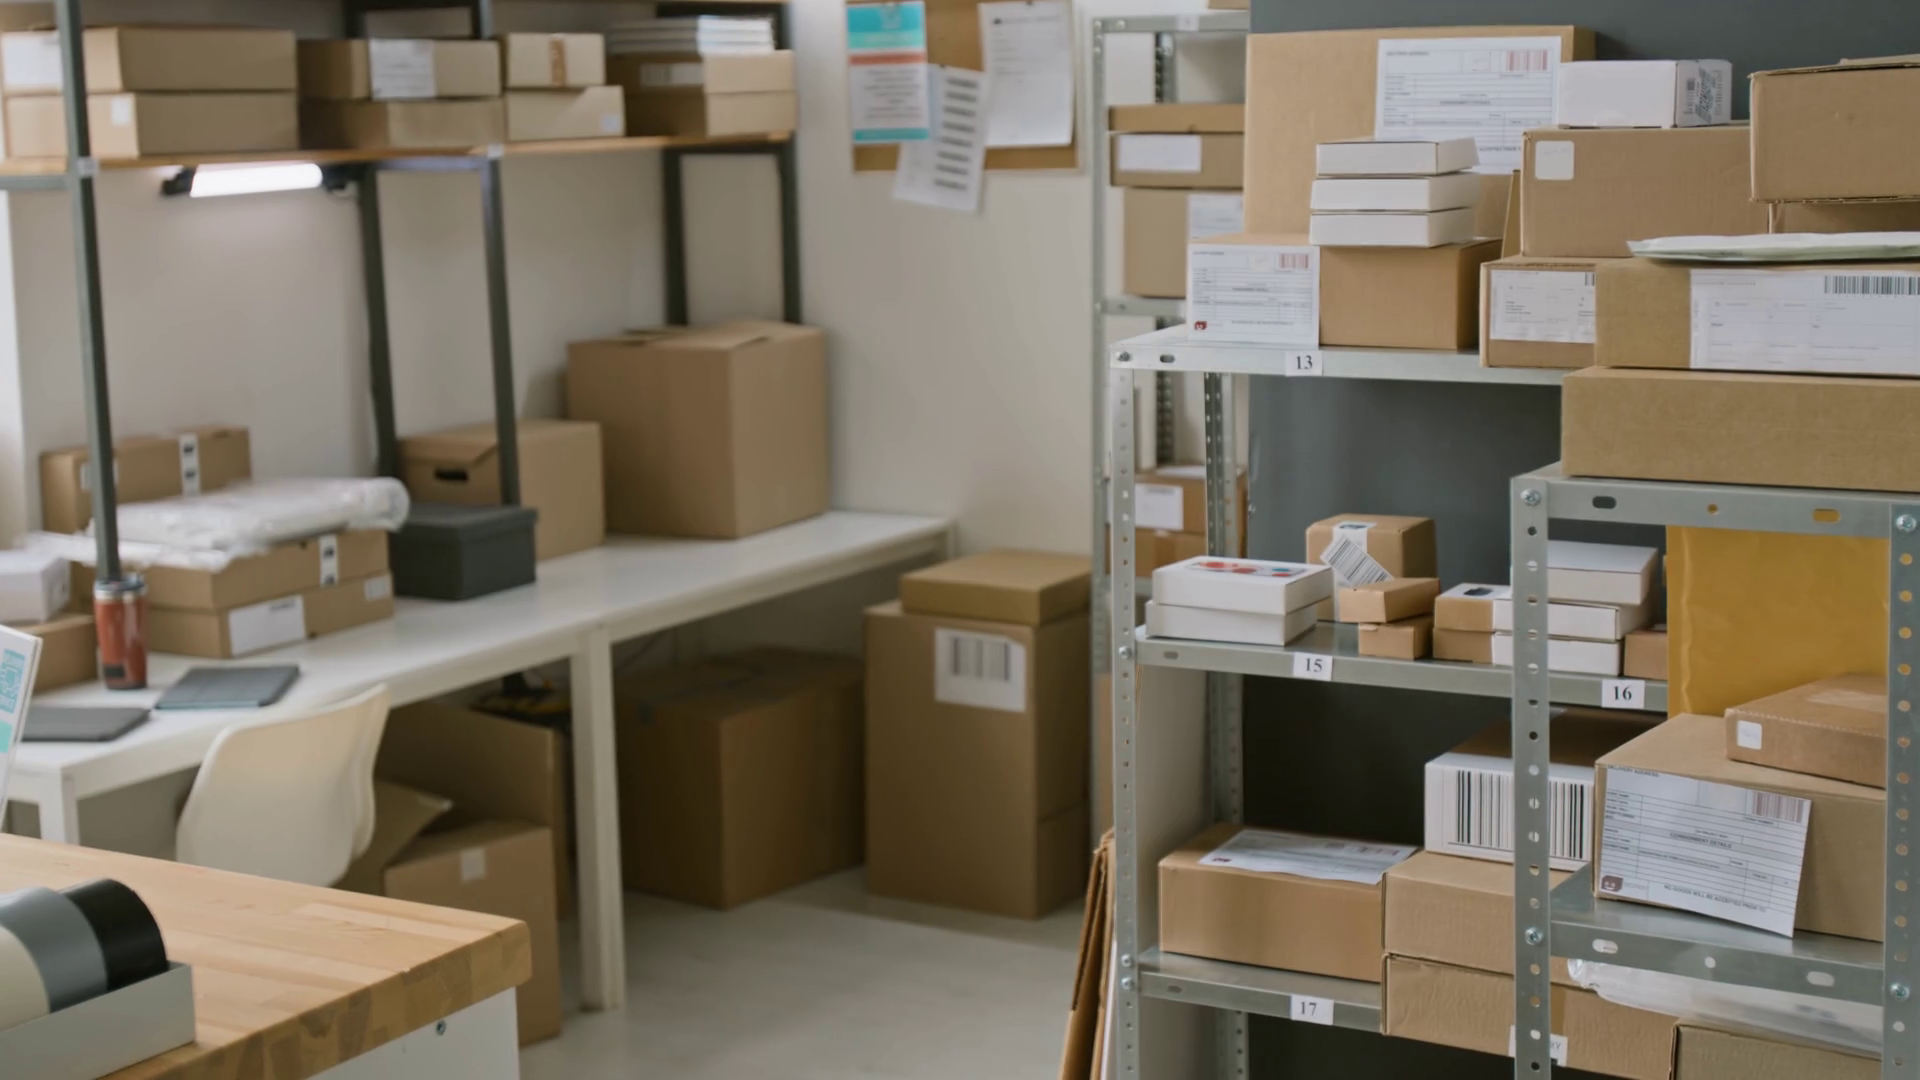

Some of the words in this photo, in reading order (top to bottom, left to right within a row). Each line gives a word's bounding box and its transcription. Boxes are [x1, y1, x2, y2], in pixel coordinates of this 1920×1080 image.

[1296, 355, 1313, 370] 13
[1306, 657, 1322, 672] 15
[1613, 685, 1632, 700] 16
[1301, 1001, 1317, 1016] 17
